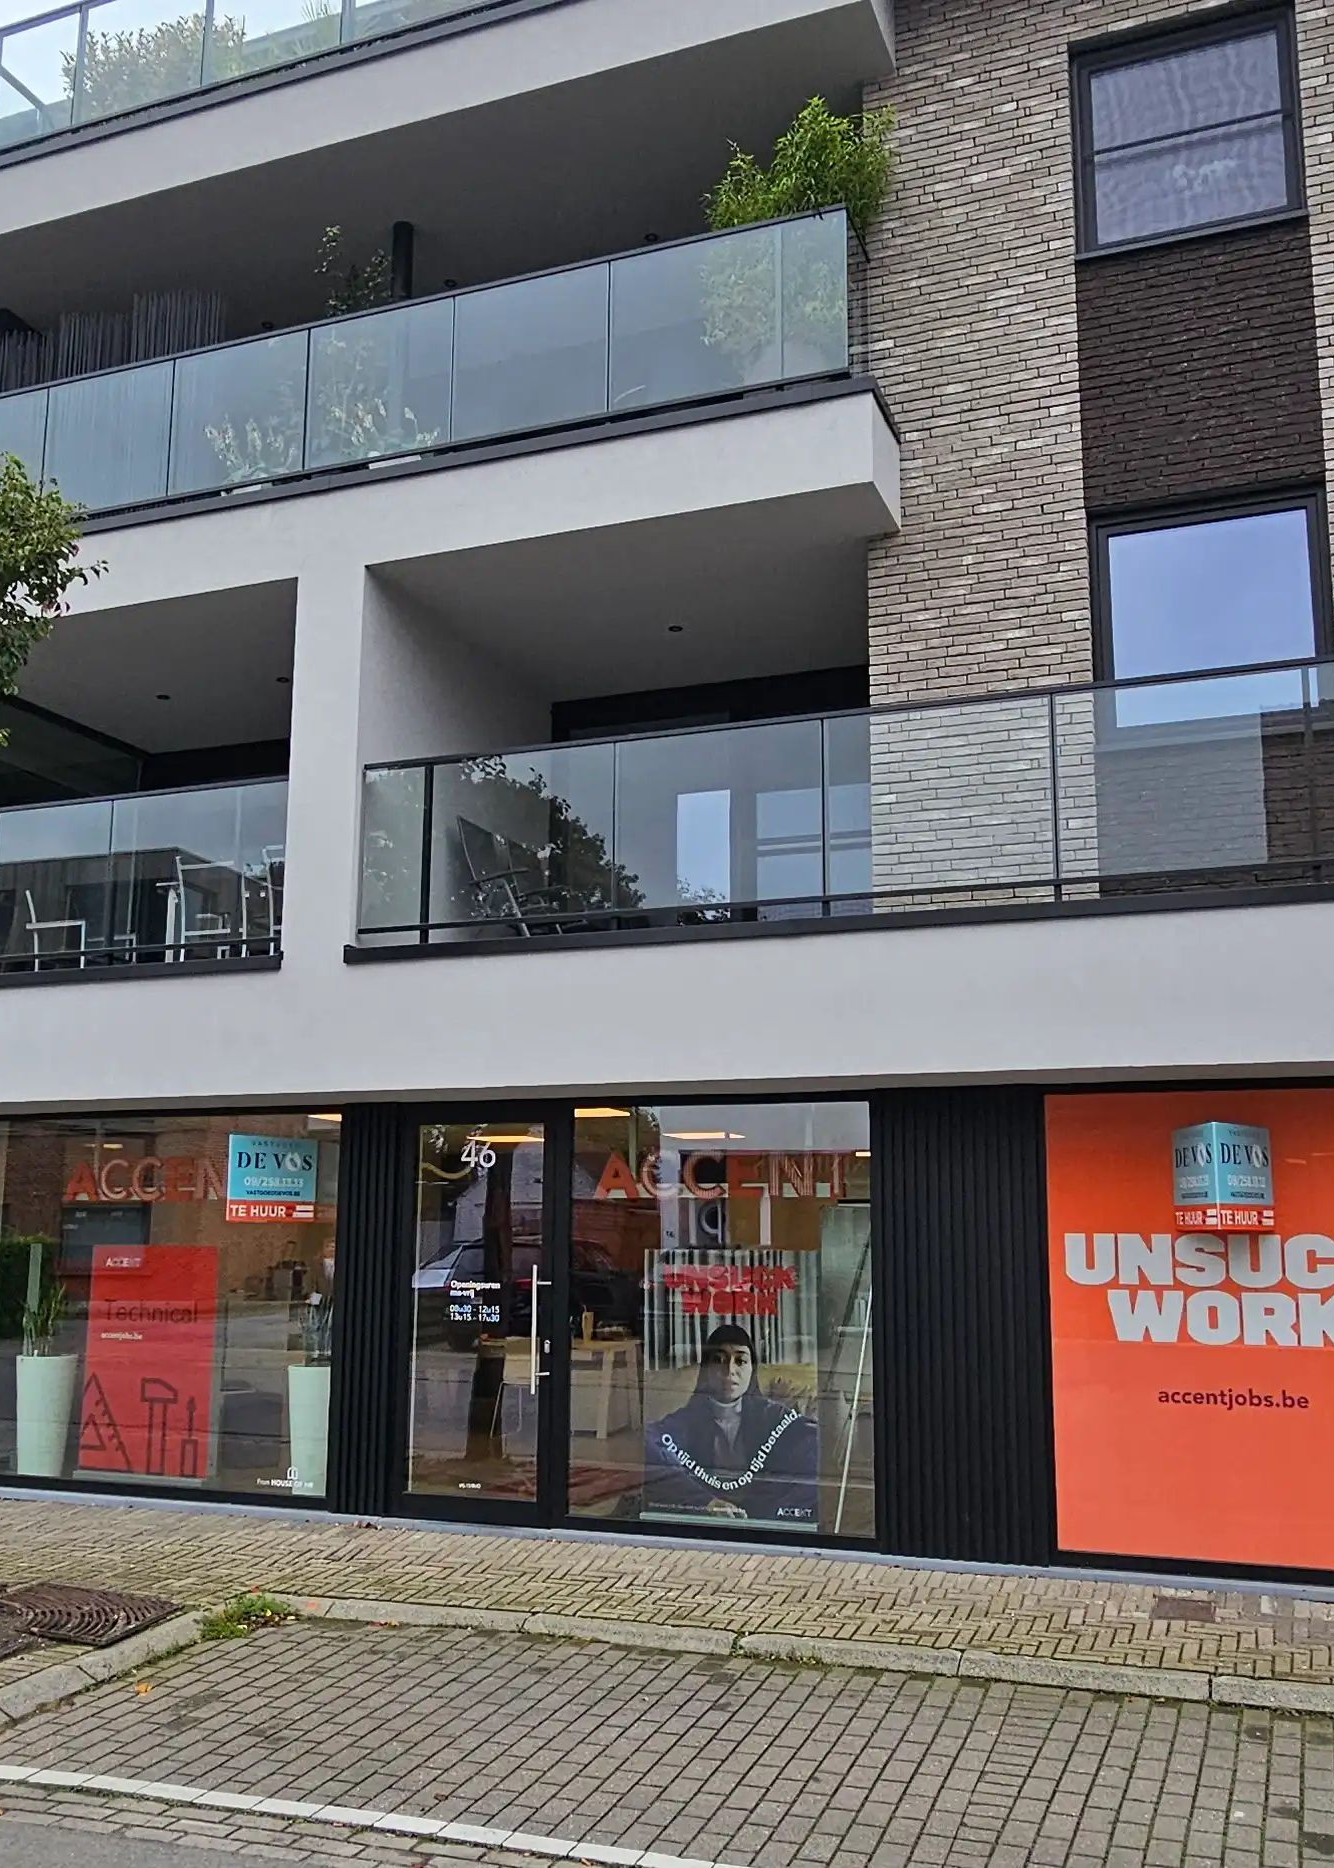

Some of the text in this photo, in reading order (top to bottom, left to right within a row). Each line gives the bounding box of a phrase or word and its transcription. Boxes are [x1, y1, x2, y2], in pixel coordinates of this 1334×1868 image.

[237, 1152, 313, 1172] DE VOS
[461, 1140, 496, 1168] 46
[1175, 1142, 1212, 1168] DE VOS
[1220, 1143, 1269, 1168] DE VOS
[62, 1156, 229, 1201] ACCEN
[594, 1150, 851, 1200] ACCENT
[230, 1204, 286, 1217] TE HUUR
[1175, 1211, 1203, 1225] TE HUUR
[1221, 1210, 1259, 1225] TE HUUR
[663, 1264, 797, 1291] UNSUCK
[104, 1299, 198, 1323] Technical
[681, 1290, 779, 1316] WORK
[1158, 1388, 1310, 1411] accentjobs.be
[661, 1408, 802, 1491] Op tijd thuis en op tijd betaald.
[271, 1479, 293, 1487] HOUSE
[777, 1507, 813, 1518] ACCENT
